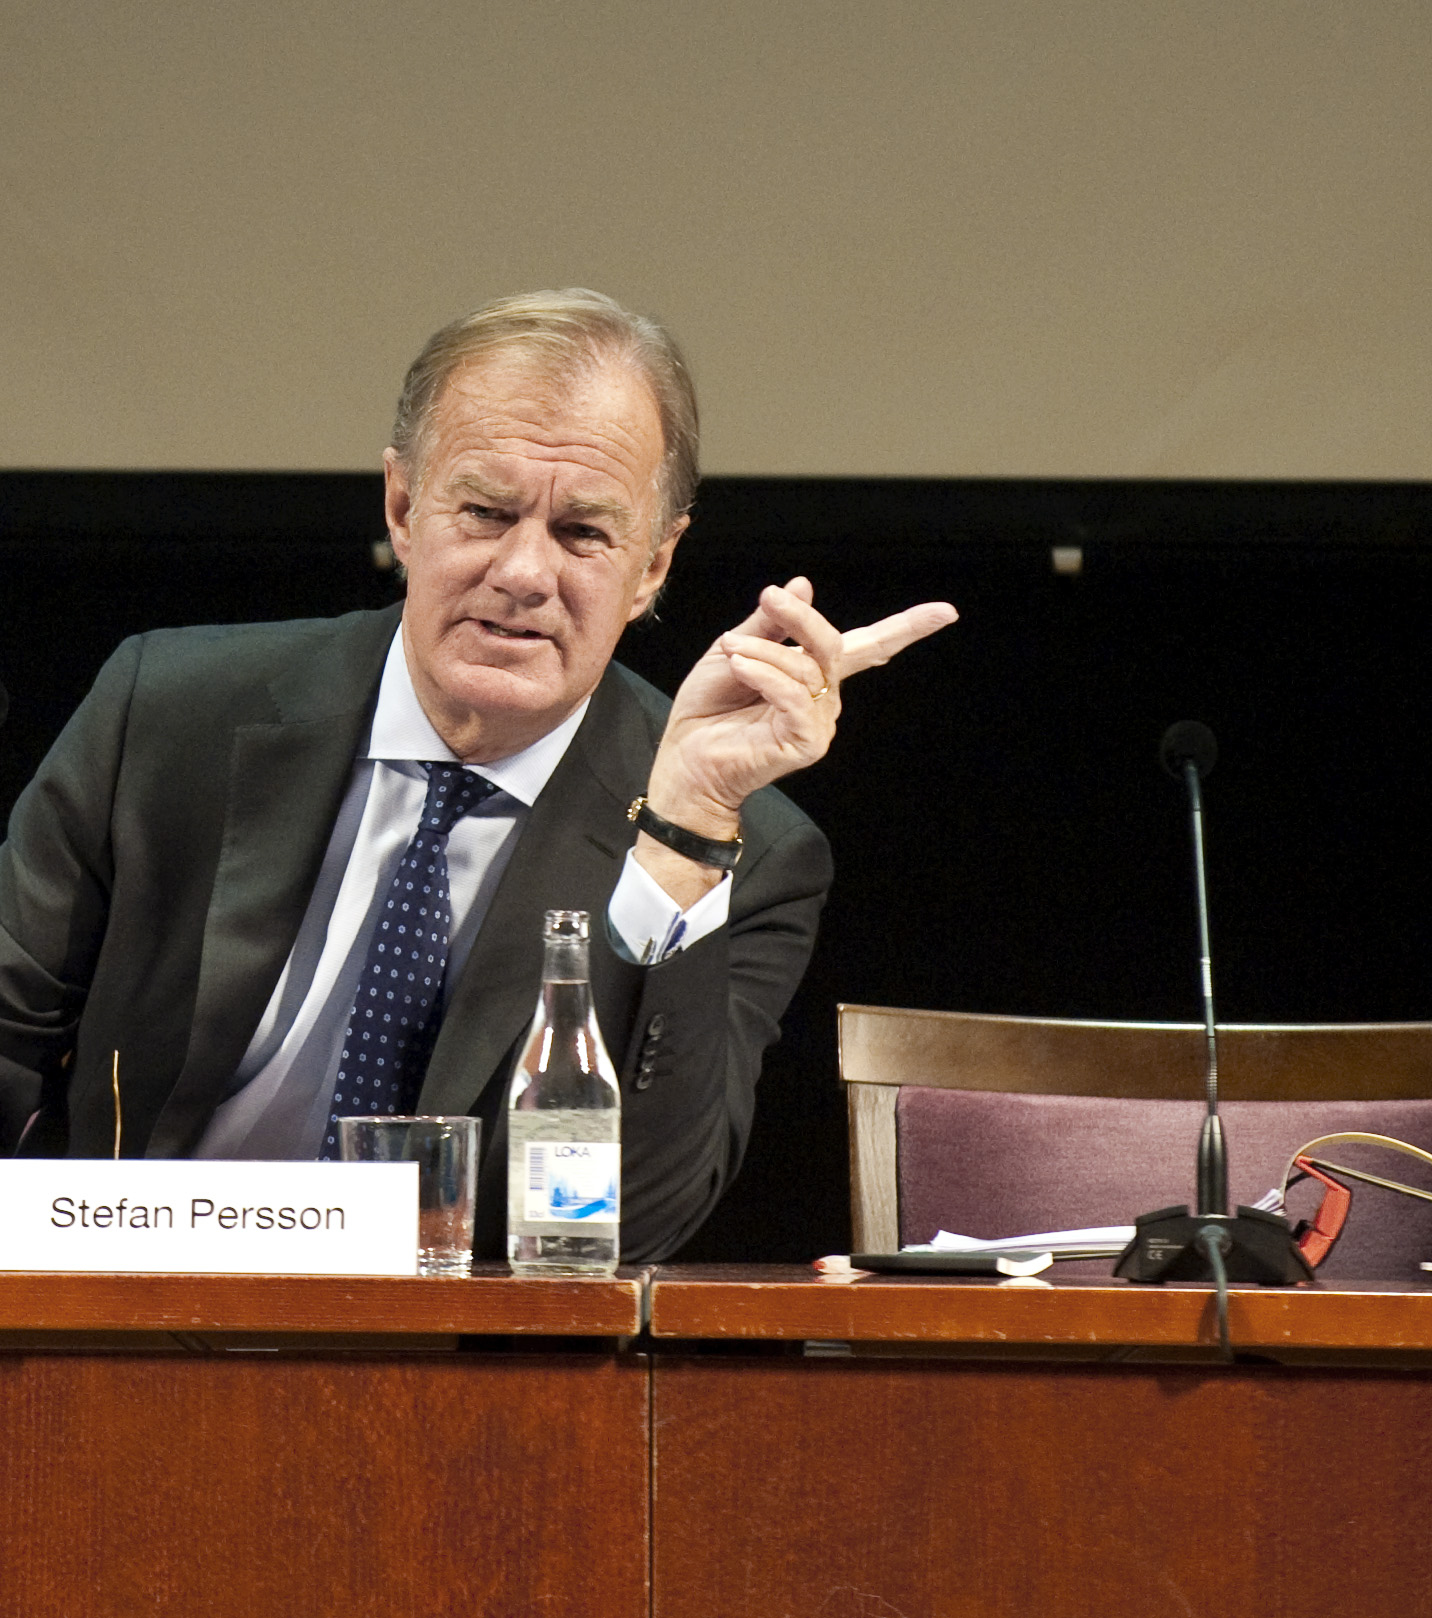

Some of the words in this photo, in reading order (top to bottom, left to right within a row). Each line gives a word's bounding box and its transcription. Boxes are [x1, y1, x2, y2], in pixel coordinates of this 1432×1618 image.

[554, 1145, 591, 1157] LOKA
[50, 1196, 174, 1230] Stefan
[190, 1197, 345, 1231] Persson
